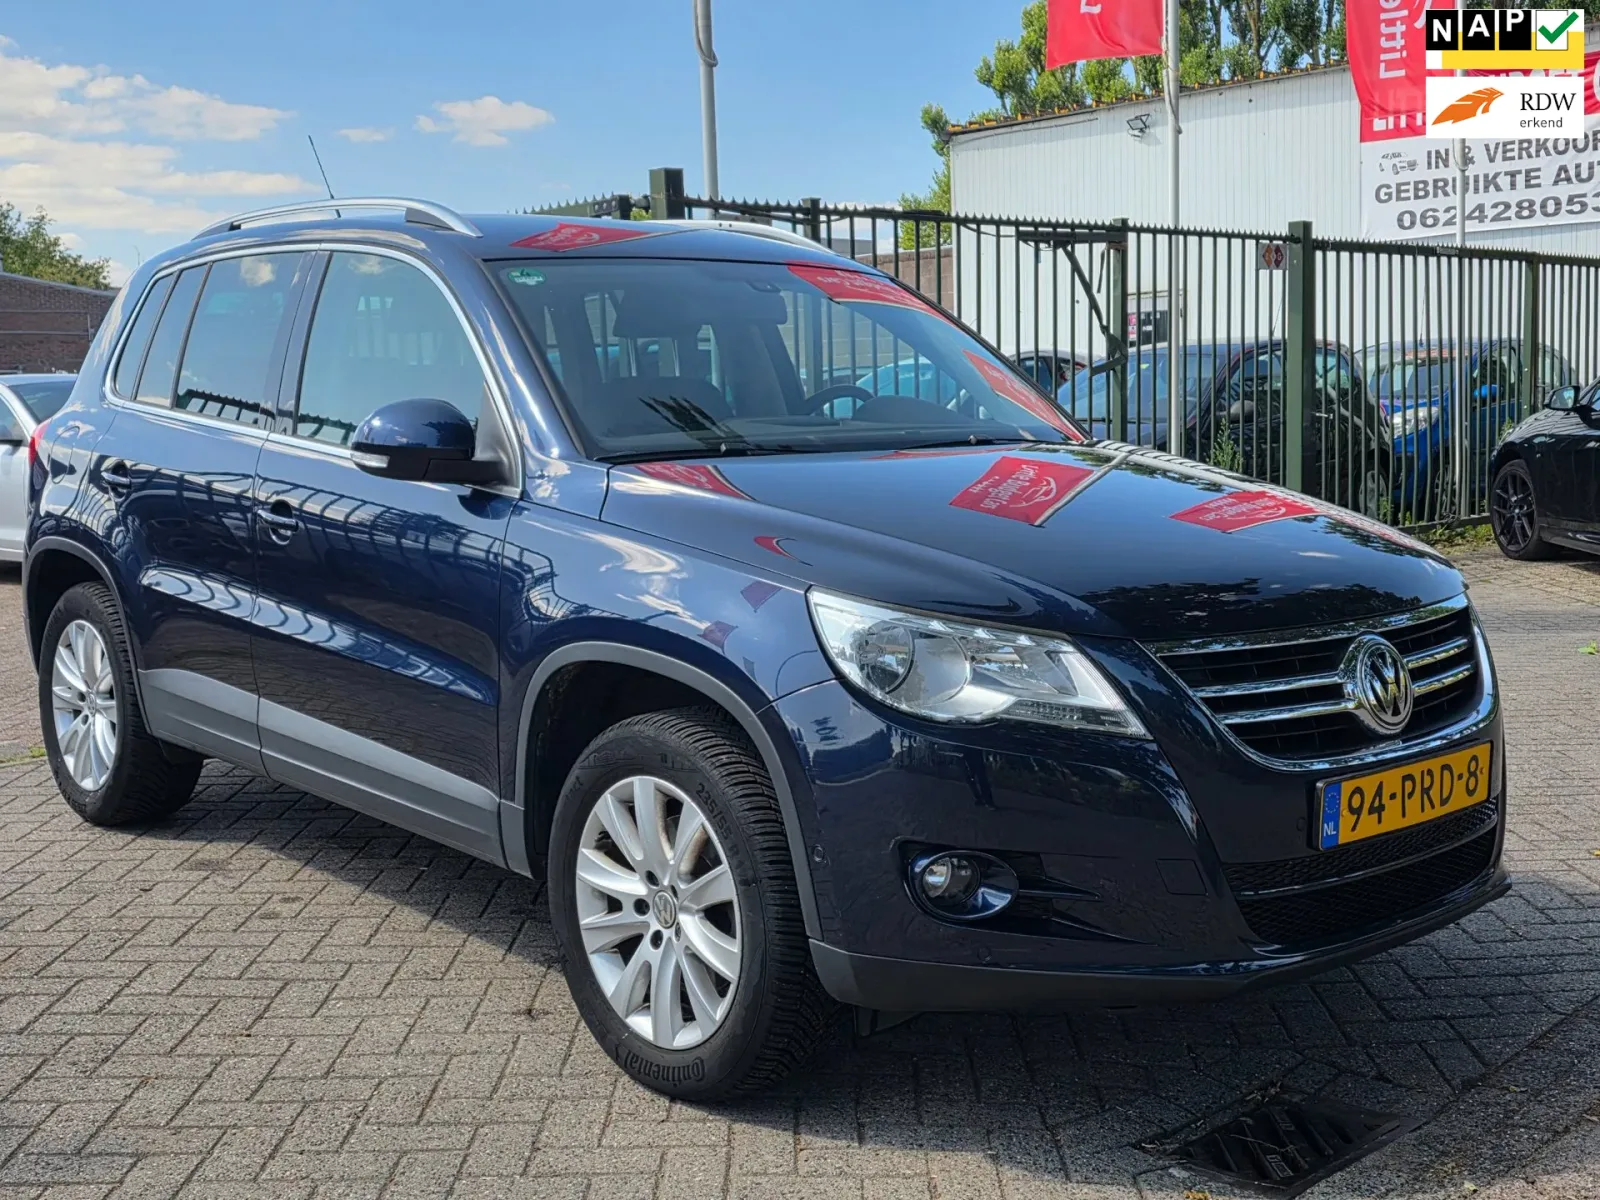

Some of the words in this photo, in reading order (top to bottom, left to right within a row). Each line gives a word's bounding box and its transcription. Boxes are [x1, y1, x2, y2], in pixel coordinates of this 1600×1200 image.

[1427, 148, 1450, 170] IN
[1552, 160, 1600, 187] AU
[1347, 754, 1480, 832] 94-PRD-8
[1323, 821, 1337, 837] NL
[623, 1050, 706, 1088] Continental
